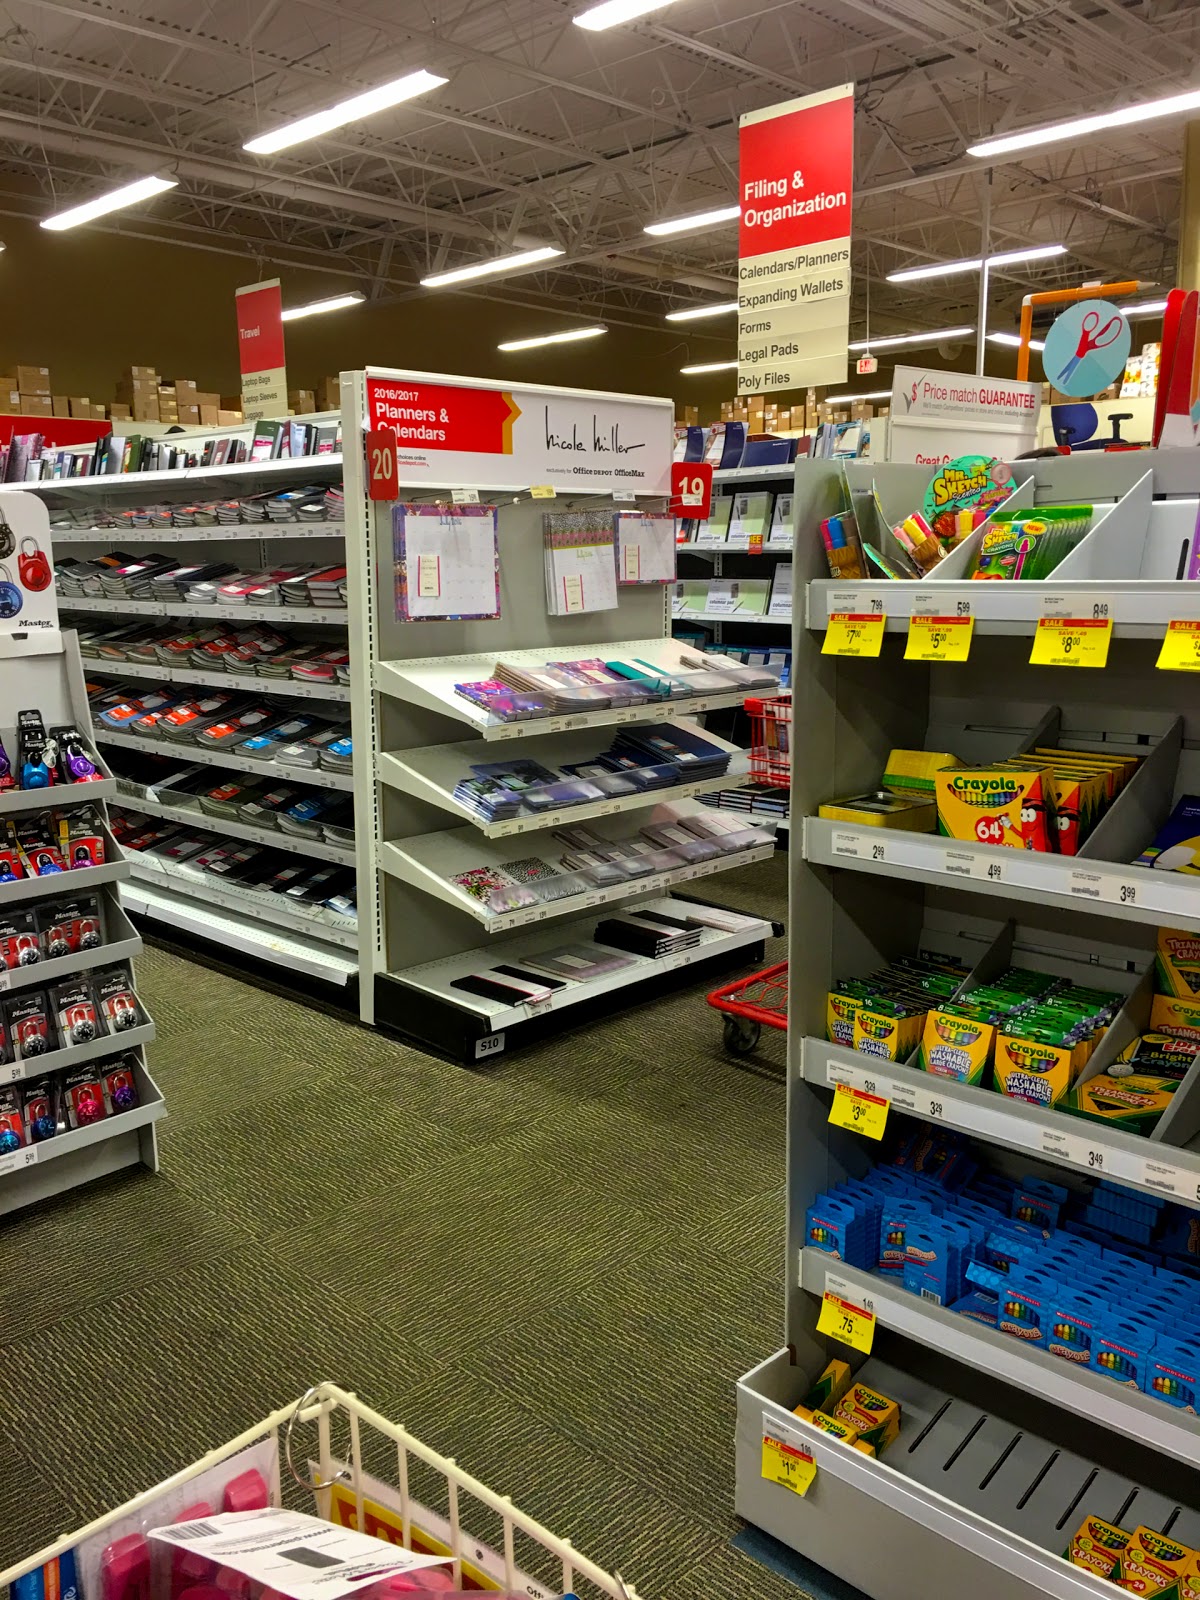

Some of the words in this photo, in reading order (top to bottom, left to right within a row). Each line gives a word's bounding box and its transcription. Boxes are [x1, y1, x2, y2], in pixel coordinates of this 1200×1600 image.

[744, 178, 788, 201] Filing
[792, 170, 805, 190] &
[744, 191, 847, 228] Organization
[739, 249, 849, 280] Calendars/Planners
[739, 288, 798, 308] Expanding
[800, 279, 844, 297] Wallets
[240, 325, 261, 340] Travel
[739, 321, 772, 335] Forms
[738, 346, 768, 363] Legal
[771, 342, 799, 357] Pads
[242, 377, 258, 387] Laptop
[258, 375, 271, 386] Bags
[738, 375, 762, 390] Poly
[764, 371, 791, 386] Files
[243, 394, 259, 404] Laptop
[259, 391, 278, 401] Sleeves
[374, 387, 419, 402] 2016/2017
[923, 381, 947, 401] Price
[949, 386, 978, 404] match
[979, 388, 1036, 409] GUARANTEE
[244, 410, 264, 421] Luggage
[375, 402, 436, 422] Planners
[439, 408, 450, 423] &
[372, 447, 393, 480] 20
[573, 466, 593, 475] Office
[614, 468, 645, 478] OfficeMax
[943, 468, 968, 482] MR.
[678, 476, 704, 500] 19
[933, 475, 988, 506] SKETCH
[986, 543, 1013, 553] CRAYONS
[18, 619, 51, 628] Master
[1044, 619, 1064, 627] SALE
[1174, 622, 1197, 630] SALE
[952, 776, 1016, 793] Crayola
[976, 821, 1002, 839] 64
[872, 844, 885, 860] 299
[987, 864, 1002, 879] 499
[1119, 885, 1136, 902] 399
[55, 910, 79, 920] Master
[921, 981, 930, 989] 16
[60, 994, 85, 1004] Master
[864, 999, 873, 1007] 16
[12, 1006, 38, 1017] Master
[938, 1004, 945, 1012] 8
[860, 1013, 892, 1029] Crayola
[938, 1016, 979, 1034] Crayola
[1005, 1024, 1012, 1033] 8
[480, 1037, 499, 1052] S10
[858, 1041, 891, 1058] WASHABLE
[935, 1044, 970, 1058] ULTRA-CLEAN
[1009, 1041, 1055, 1060] Crayola
[929, 1050, 972, 1069] WASHABLE
[1150, 1051, 1194, 1064] Bright
[930, 1059, 946, 1069] LARGE
[946, 1061, 970, 1075] CRAYONS
[66, 1073, 92, 1084] Master
[1010, 1071, 1049, 1086] ULTRA-CLEAN
[1005, 1077, 1053, 1097] WASHABLE
[1007, 1086, 1025, 1095] LARGE
[1025, 1089, 1051, 1104] CRAYONS
[1094, 1085, 1157, 1106] TRIANGULAR
[929, 1101, 943, 1115] 329
[1088, 1151, 1104, 1166] 349
[1010, 1291, 1041, 1306] SCHOLASTIC
[838, 1316, 854, 1334] .75
[1063, 1313, 1093, 1329] SCHOLASTIC
[1000, 1321, 1043, 1340] crayons
[1107, 1340, 1139, 1359] SCHOLASTIC
[1162, 1365, 1196, 1383] SCHOLASTIC
[858, 1388, 888, 1408] Crayola
[817, 1415, 847, 1435] Crayola
[835, 1409, 869, 1431] CRAYONS
[1092, 1522, 1130, 1544] Crayola
[1143, 1532, 1183, 1556] Crayola
[1071, 1548, 1114, 1575] CRAYONS
[1123, 1561, 1169, 1588] CRAYONS
[1132, 1580, 1145, 1590] 24
